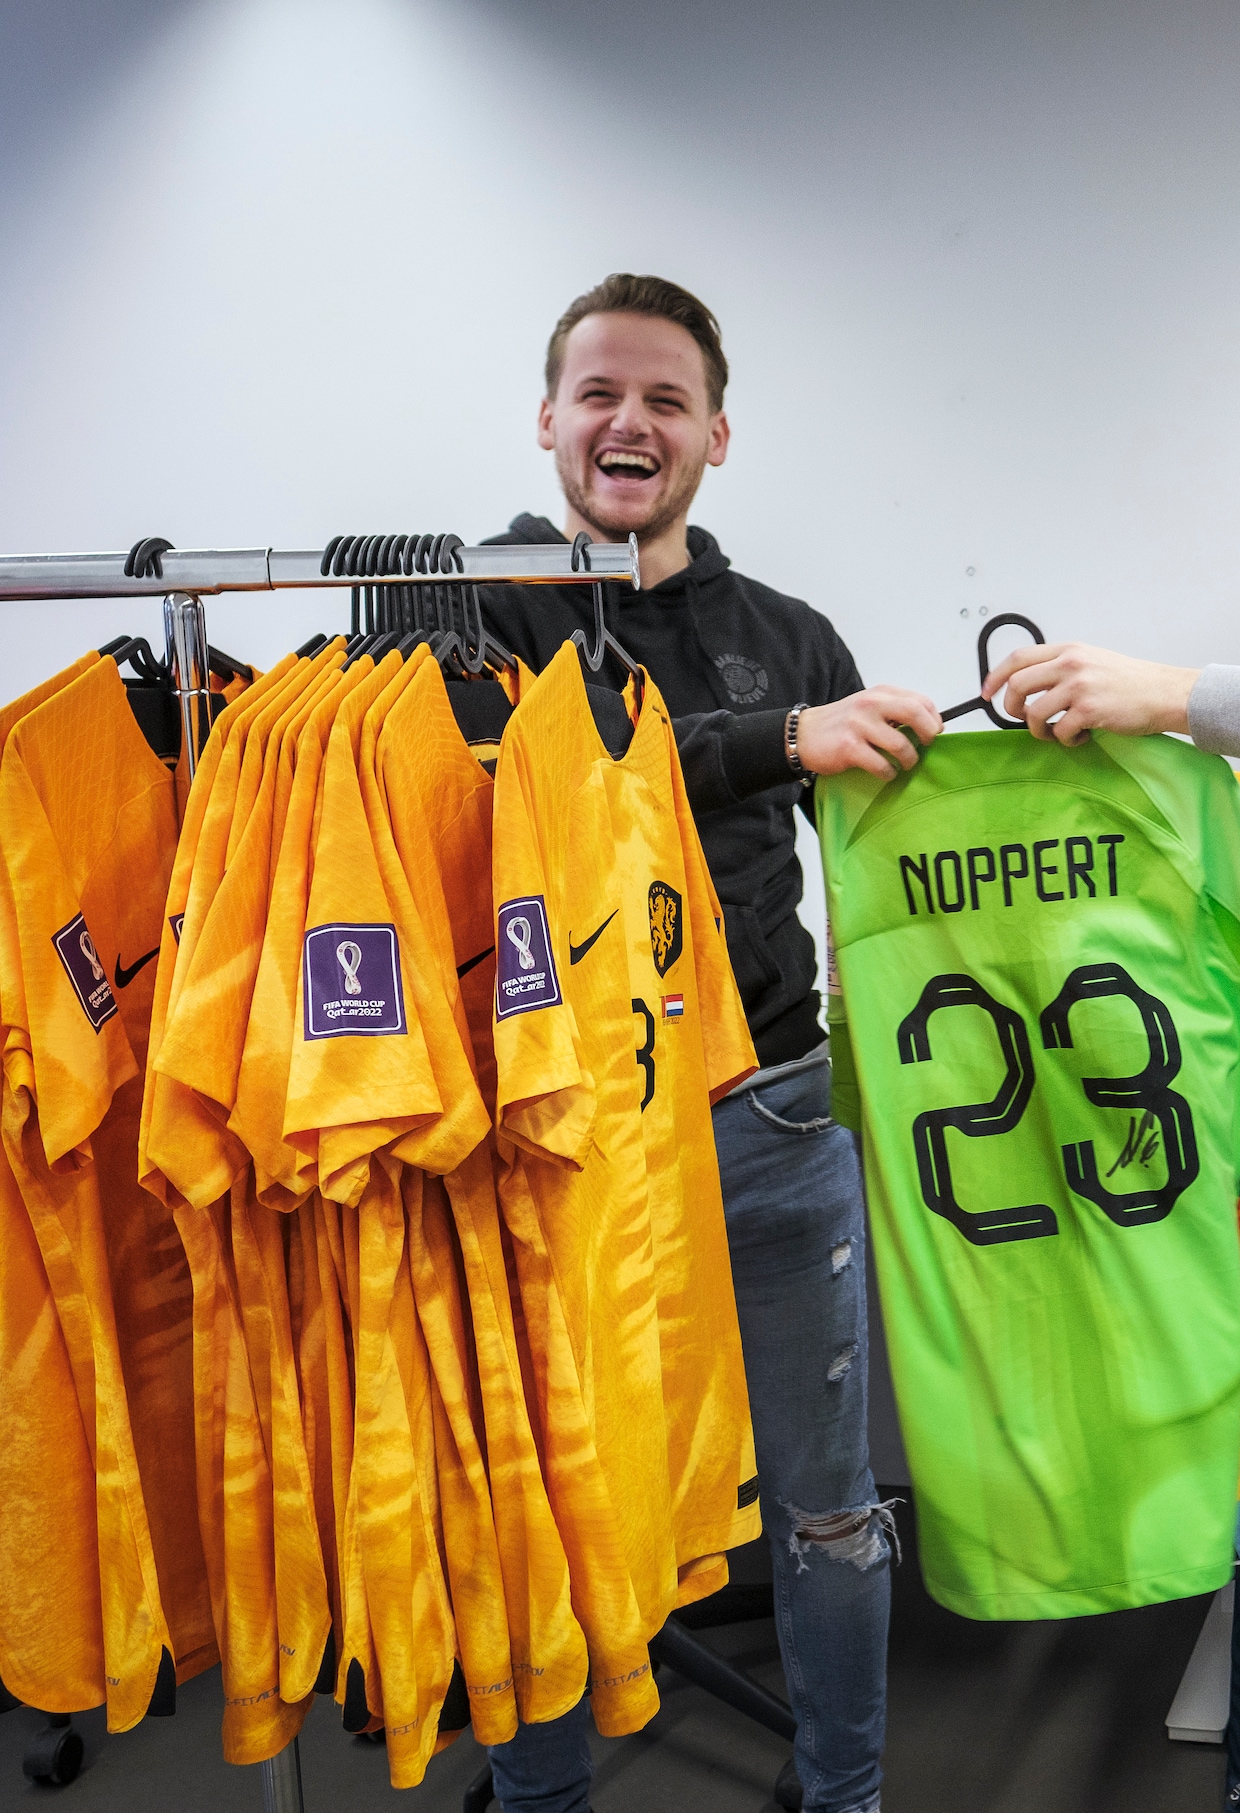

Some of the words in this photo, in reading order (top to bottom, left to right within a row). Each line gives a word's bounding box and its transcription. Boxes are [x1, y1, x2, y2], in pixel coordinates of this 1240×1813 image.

[899, 834, 1124, 915] NOPPERT
[322, 1000, 341, 1011] FIFA
[340, 999, 370, 1008] WORLD
[369, 1000, 386, 1008] CUP
[502, 979, 519, 990] FIFA
[897, 962, 1200, 1246] 23
